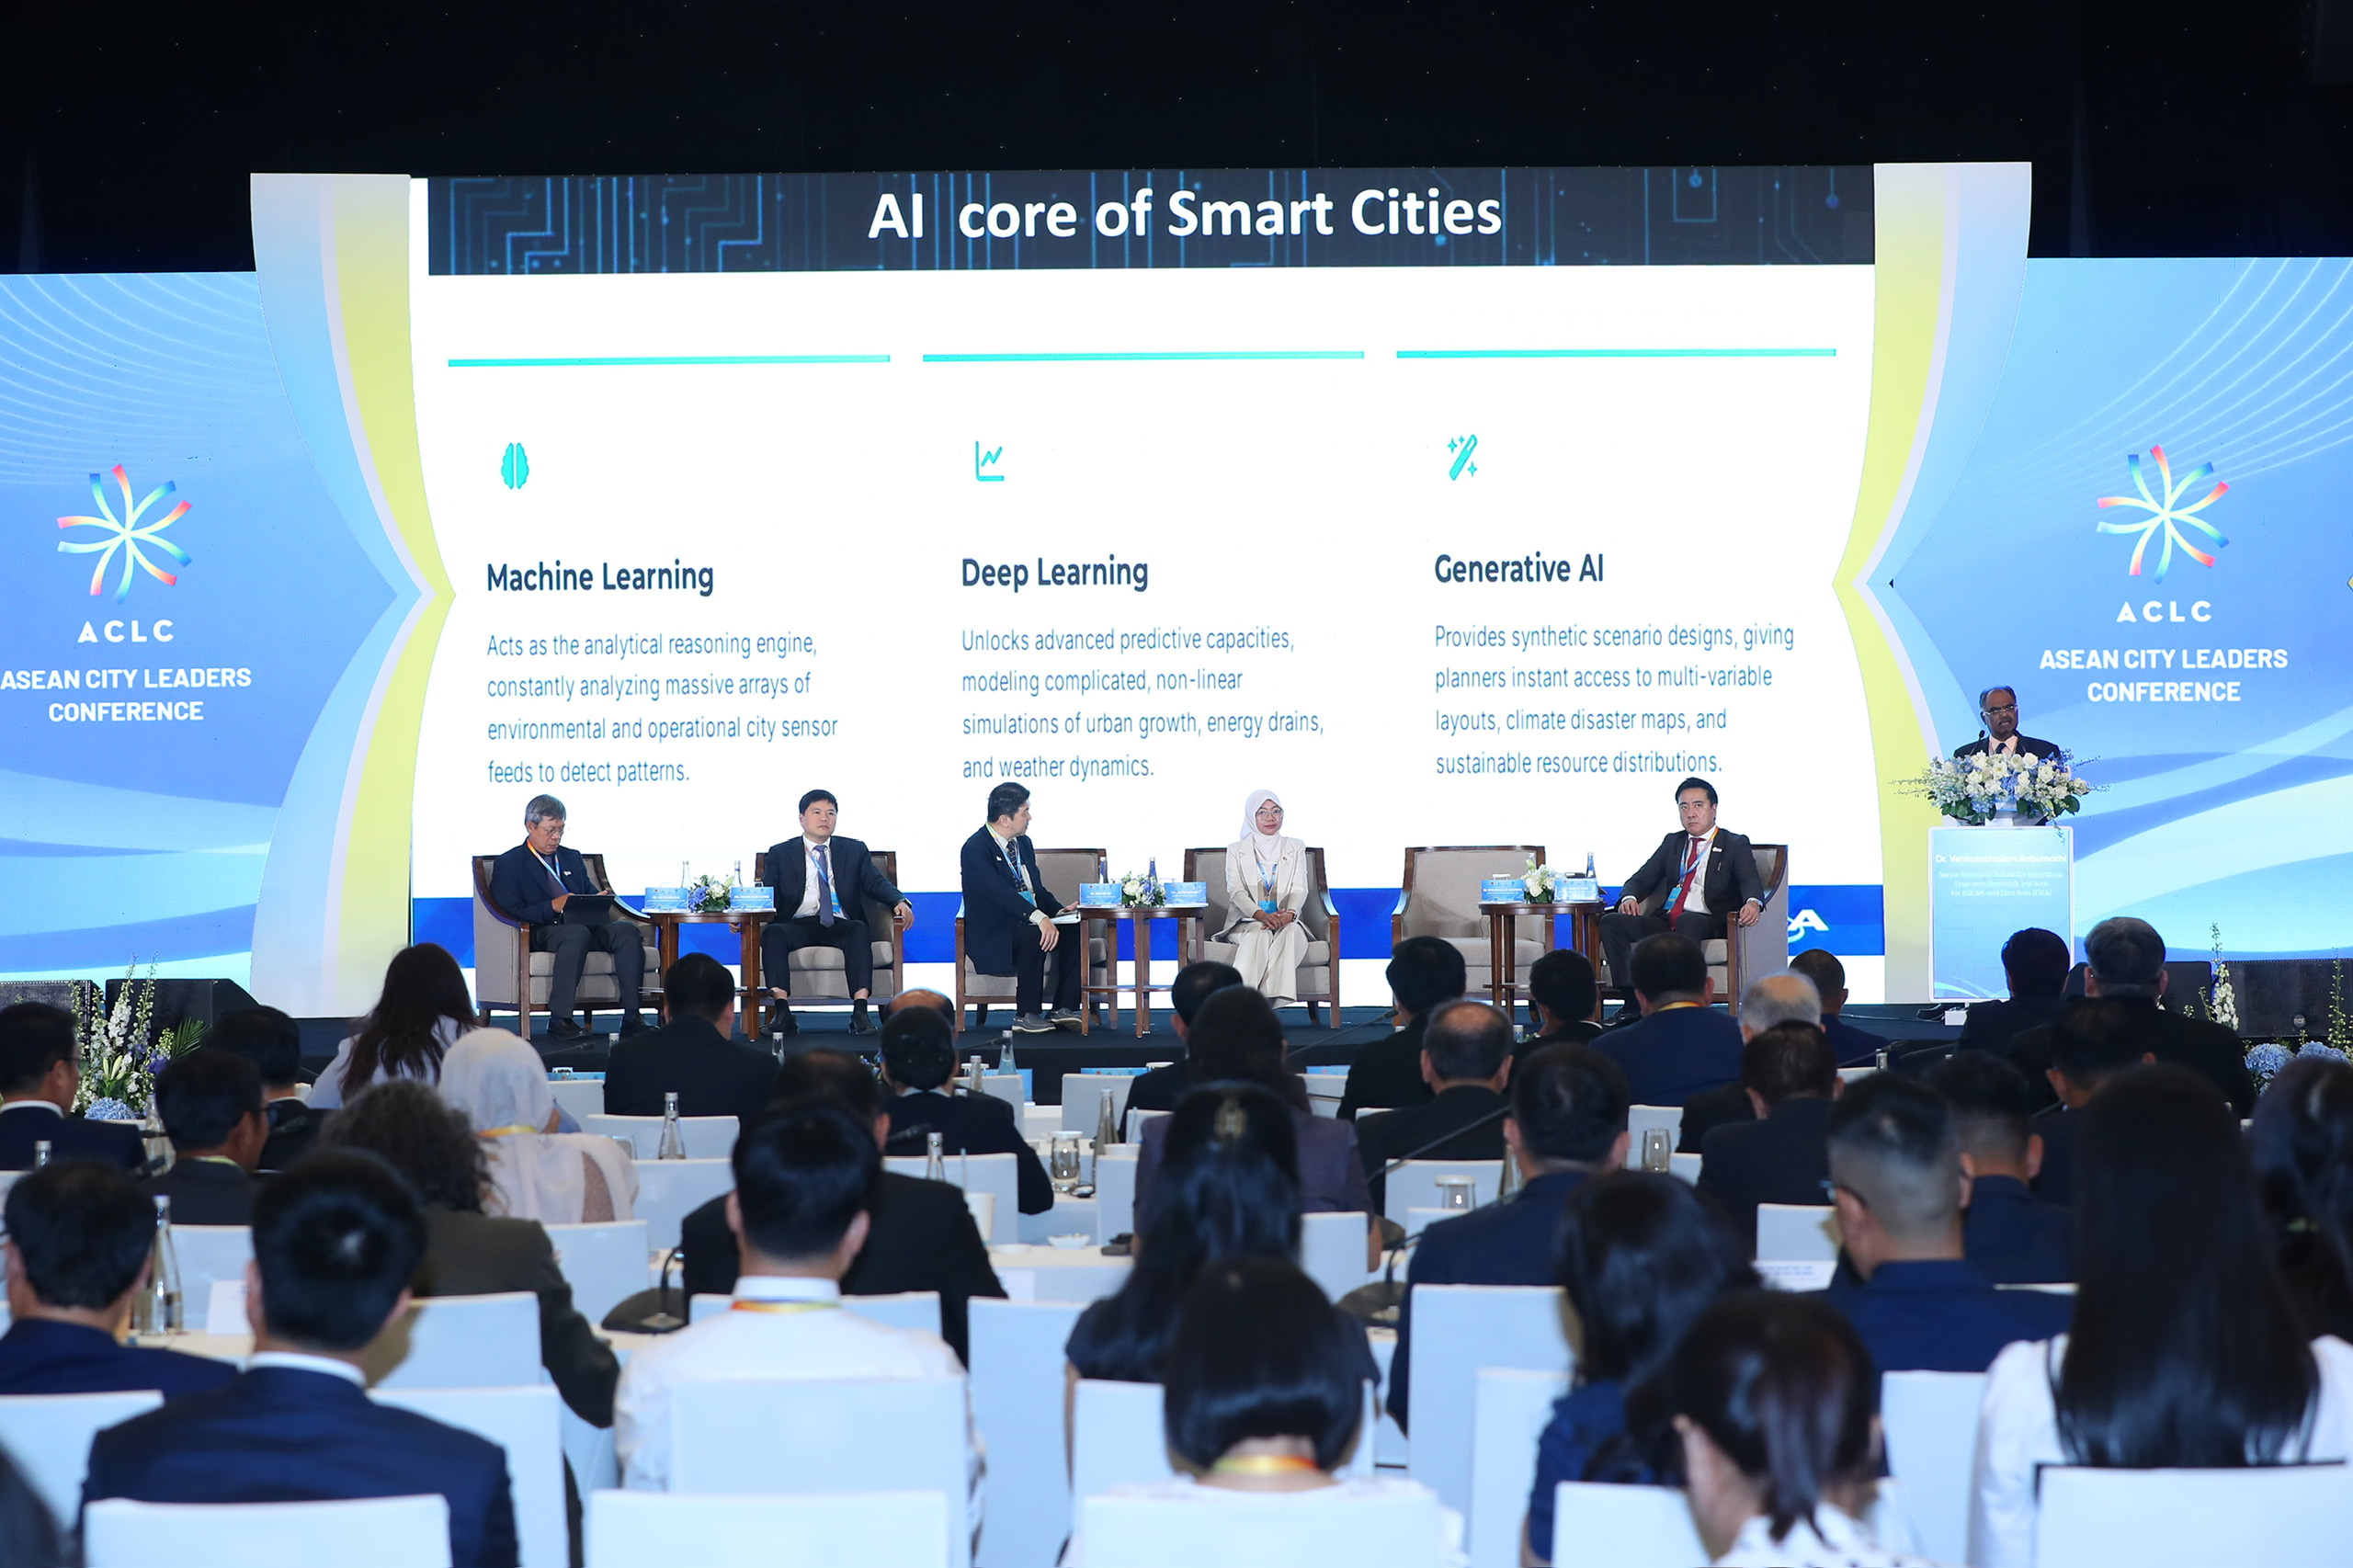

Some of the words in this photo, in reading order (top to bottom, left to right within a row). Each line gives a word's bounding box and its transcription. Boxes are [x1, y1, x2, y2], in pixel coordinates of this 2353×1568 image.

[868, 193, 923, 238] AI
[959, 202, 1077, 238] core
[1096, 187, 1153, 237] of
[1168, 190, 1334, 236] Smart
[1351, 187, 1502, 235] Cities
[488, 560, 593, 591] Machine
[603, 558, 713, 597] Learning
[962, 559, 1029, 593] Deep
[1039, 554, 1147, 592] Learning
[1435, 551, 1570, 583] Generative
[1579, 553, 1603, 581] AI
[2117, 600, 2211, 622] ACLC
[77, 619, 174, 643] ACLC
[962, 629, 1029, 651] Unlocks
[1035, 628, 1114, 650] advanced
[1120, 627, 1201, 654] predictive
[1207, 626, 1294, 653] capacities,
[1436, 625, 1506, 647] Provides
[1512, 624, 1587, 652] synthetic
[1594, 624, 1662, 646] scenario
[1668, 623, 1737, 651] designs,
[1744, 623, 1793, 651] giving
[487, 635, 523, 655] Acts
[529, 640, 547, 655] as
[553, 634, 579, 654] the
[585, 633, 662, 660] analytical
[669, 632, 751, 659] reasoning
[756, 631, 816, 658] engine,
[2040, 649, 2119, 669] ASEAN
[2124, 649, 2176, 669] CITY
[2182, 649, 2288, 669] LEADERS
[0, 669, 80, 689] ASEAN
[85, 669, 138, 688] CITY
[144, 667, 252, 688] LEADERS
[488, 676, 574, 702] constantly
[580, 675, 659, 701] analyzing
[666, 674, 733, 695] massive
[739, 677, 789, 699] arrays
[794, 672, 811, 693] of
[963, 670, 1039, 697] modeling
[1045, 669, 1151, 696] complicated,
[1157, 668, 1243, 690] non-linear
[1436, 667, 1506, 693] planners
[1513, 666, 1568, 687] instant
[1574, 670, 1631, 687] access
[1636, 667, 1652, 687] to
[1658, 665, 1772, 687] multi-variable
[2087, 681, 2241, 702] CONFERENCE
[49, 701, 204, 722] CONFERENCE
[963, 713, 1059, 734] simulations
[1065, 711, 1081, 733] of
[1086, 713, 1132, 733] urban
[1139, 712, 1200, 739] growth,
[1208, 716, 1263, 738] energy
[1268, 710, 1323, 735] drains,
[1437, 710, 1500, 736] layouts,
[1506, 709, 1566, 730] climate
[1571, 709, 1636, 730] disaster
[1642, 713, 1690, 734] maps,
[1697, 709, 1726, 729] and
[488, 718, 605, 740] environmental
[612, 718, 642, 739] and
[648, 716, 740, 743] operational
[746, 715, 776, 743] city
[782, 720, 838, 737] sensor
[488, 760, 533, 783] feeds
[539, 762, 554, 782] to
[561, 761, 611, 782] detect
[618, 761, 689, 787] patterns.
[963, 756, 993, 778] and
[999, 756, 1065, 778] weather
[1070, 755, 1154, 780] dynamics.
[1437, 752, 1531, 774] sustainable
[1537, 756, 1608, 773] resource
[1613, 750, 1722, 773] distributions.
[1936, 855, 1948, 863] Dr.
